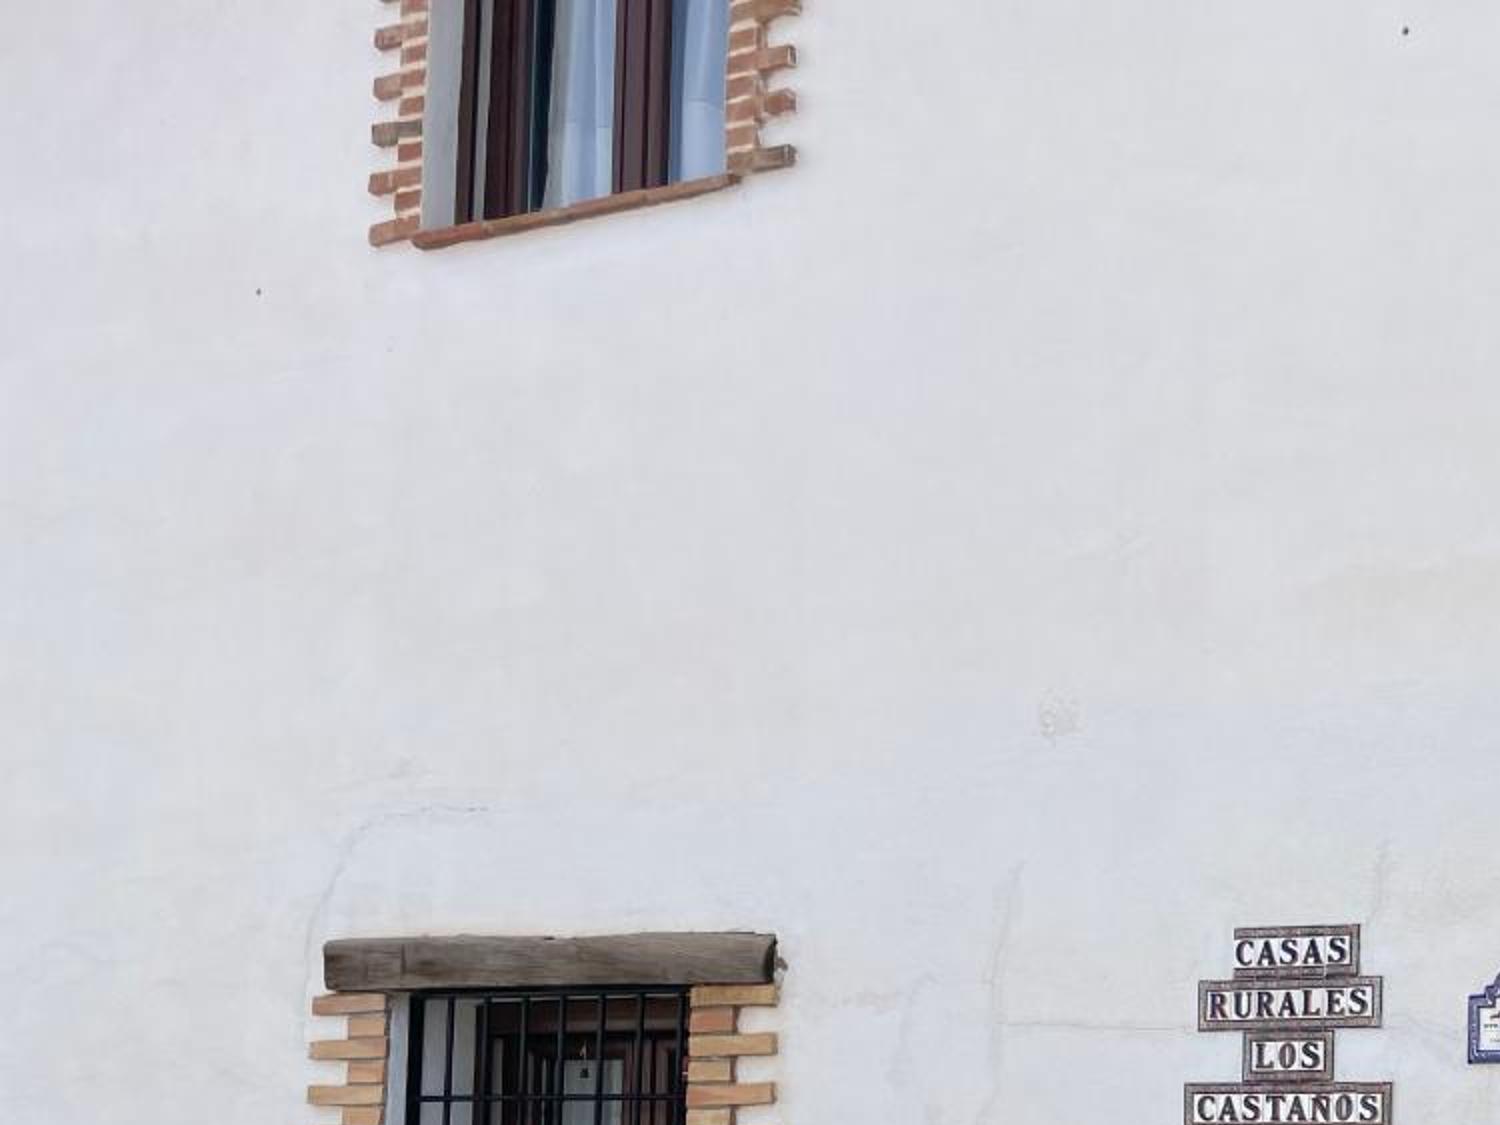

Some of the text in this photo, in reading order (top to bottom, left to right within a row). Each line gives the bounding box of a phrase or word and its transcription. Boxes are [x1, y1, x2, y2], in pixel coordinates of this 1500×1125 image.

[1235, 937, 1347, 966] CASAS
[1209, 988, 1368, 1019] RURALES
[1254, 1041, 1321, 1069] LOS
[1197, 1094, 1378, 1122] CASTAÑOS
